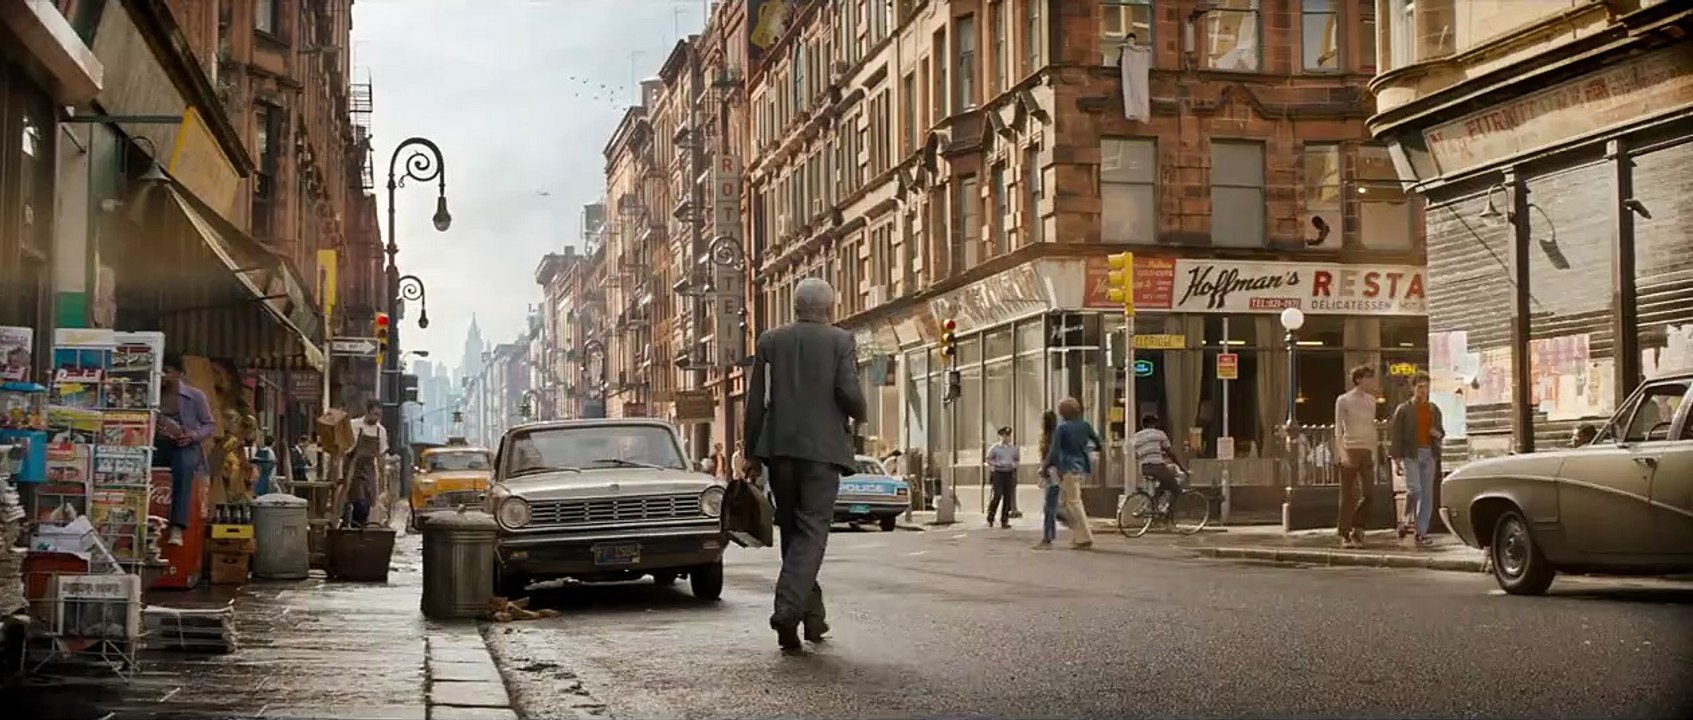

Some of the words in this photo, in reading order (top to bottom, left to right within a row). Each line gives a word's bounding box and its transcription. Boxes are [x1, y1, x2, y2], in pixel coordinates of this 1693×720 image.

[722, 158, 736, 362] ROTTEIN
[1178, 265, 1300, 309] Hoffman's
[1311, 300, 1392, 311] DELICATESSEN
[1390, 362, 1417, 376] OPEN
